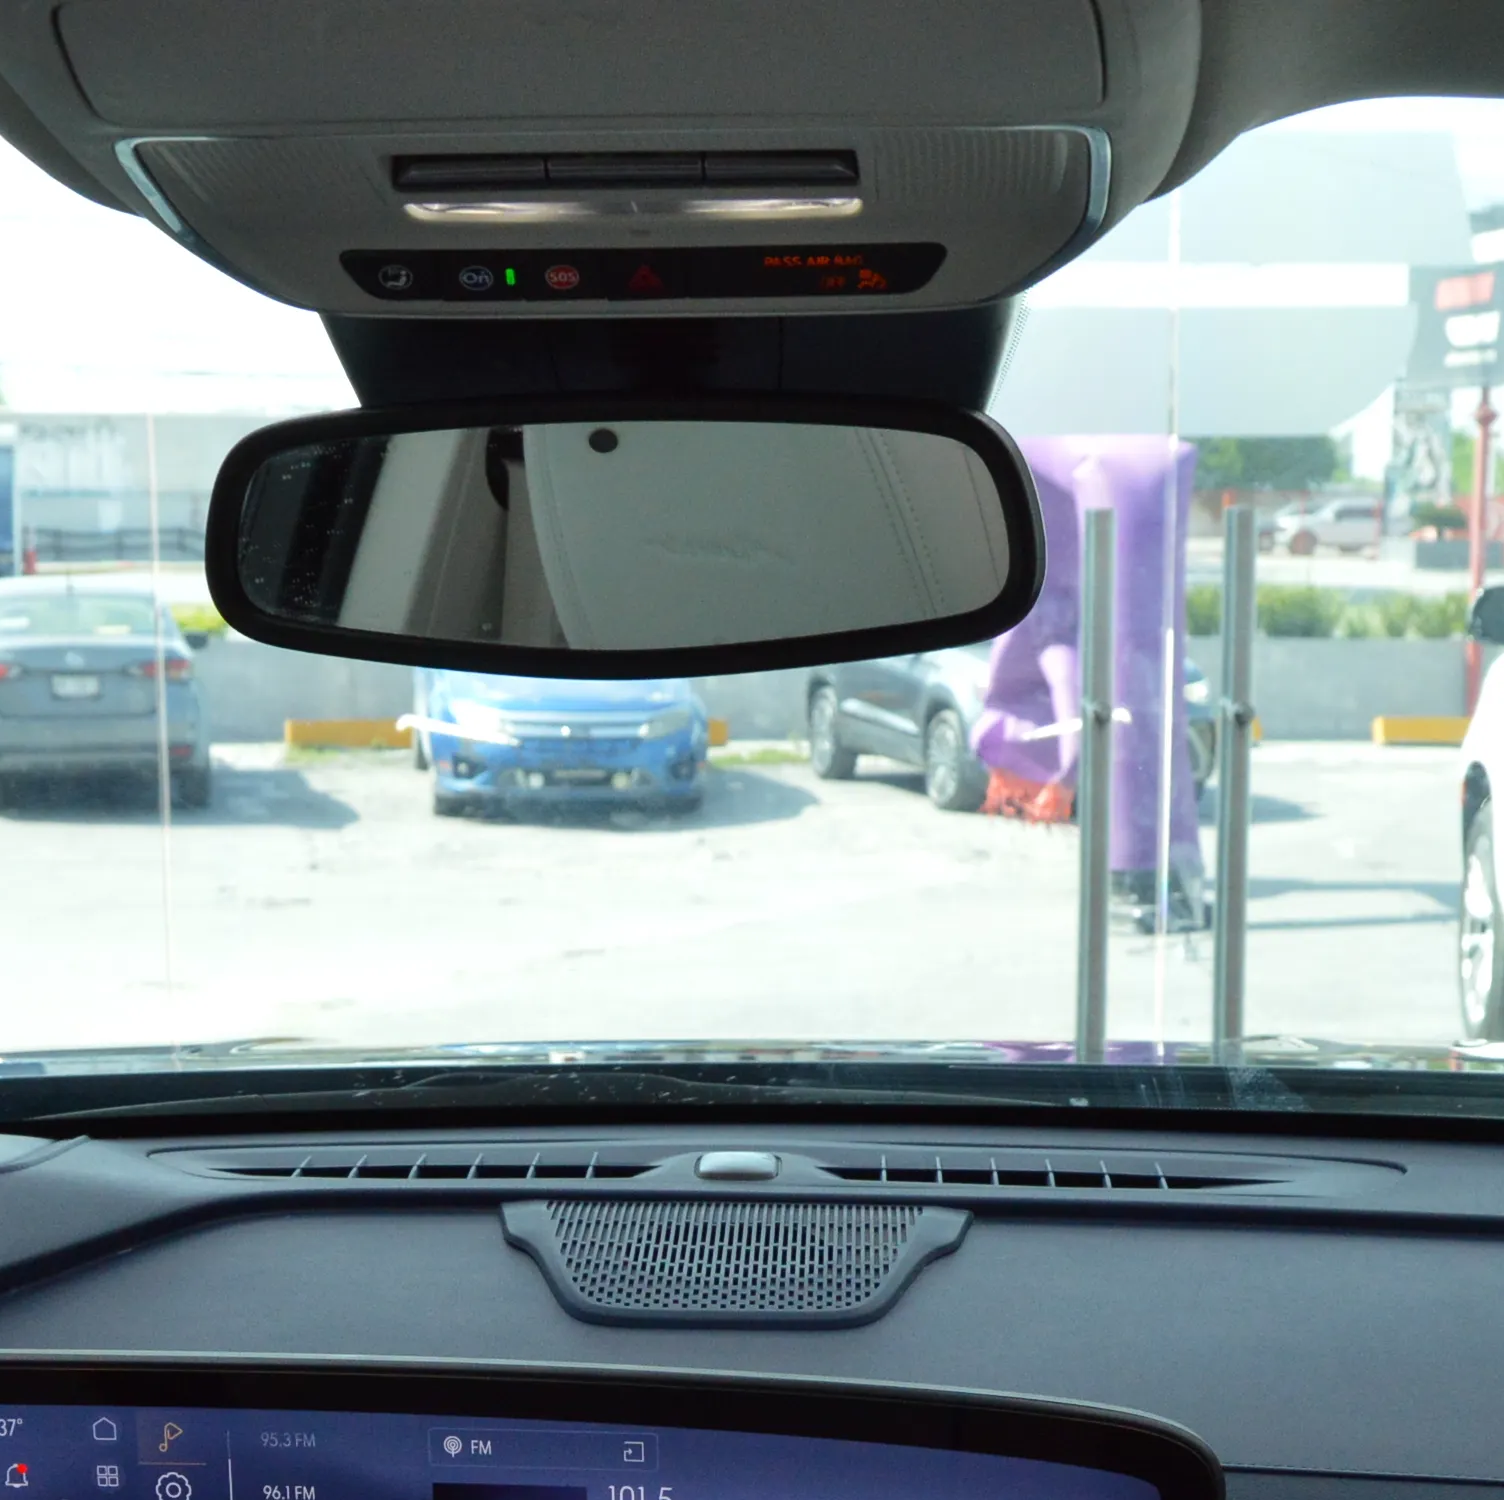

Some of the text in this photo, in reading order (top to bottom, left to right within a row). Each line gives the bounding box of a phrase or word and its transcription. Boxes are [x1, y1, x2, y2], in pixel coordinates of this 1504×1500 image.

[549, 268, 578, 282] SOS
[260, 1432, 316, 1448] 95.3 FM
[470, 1440, 492, 1456] FM
[262, 1485, 316, 1500] 96.1 FM
